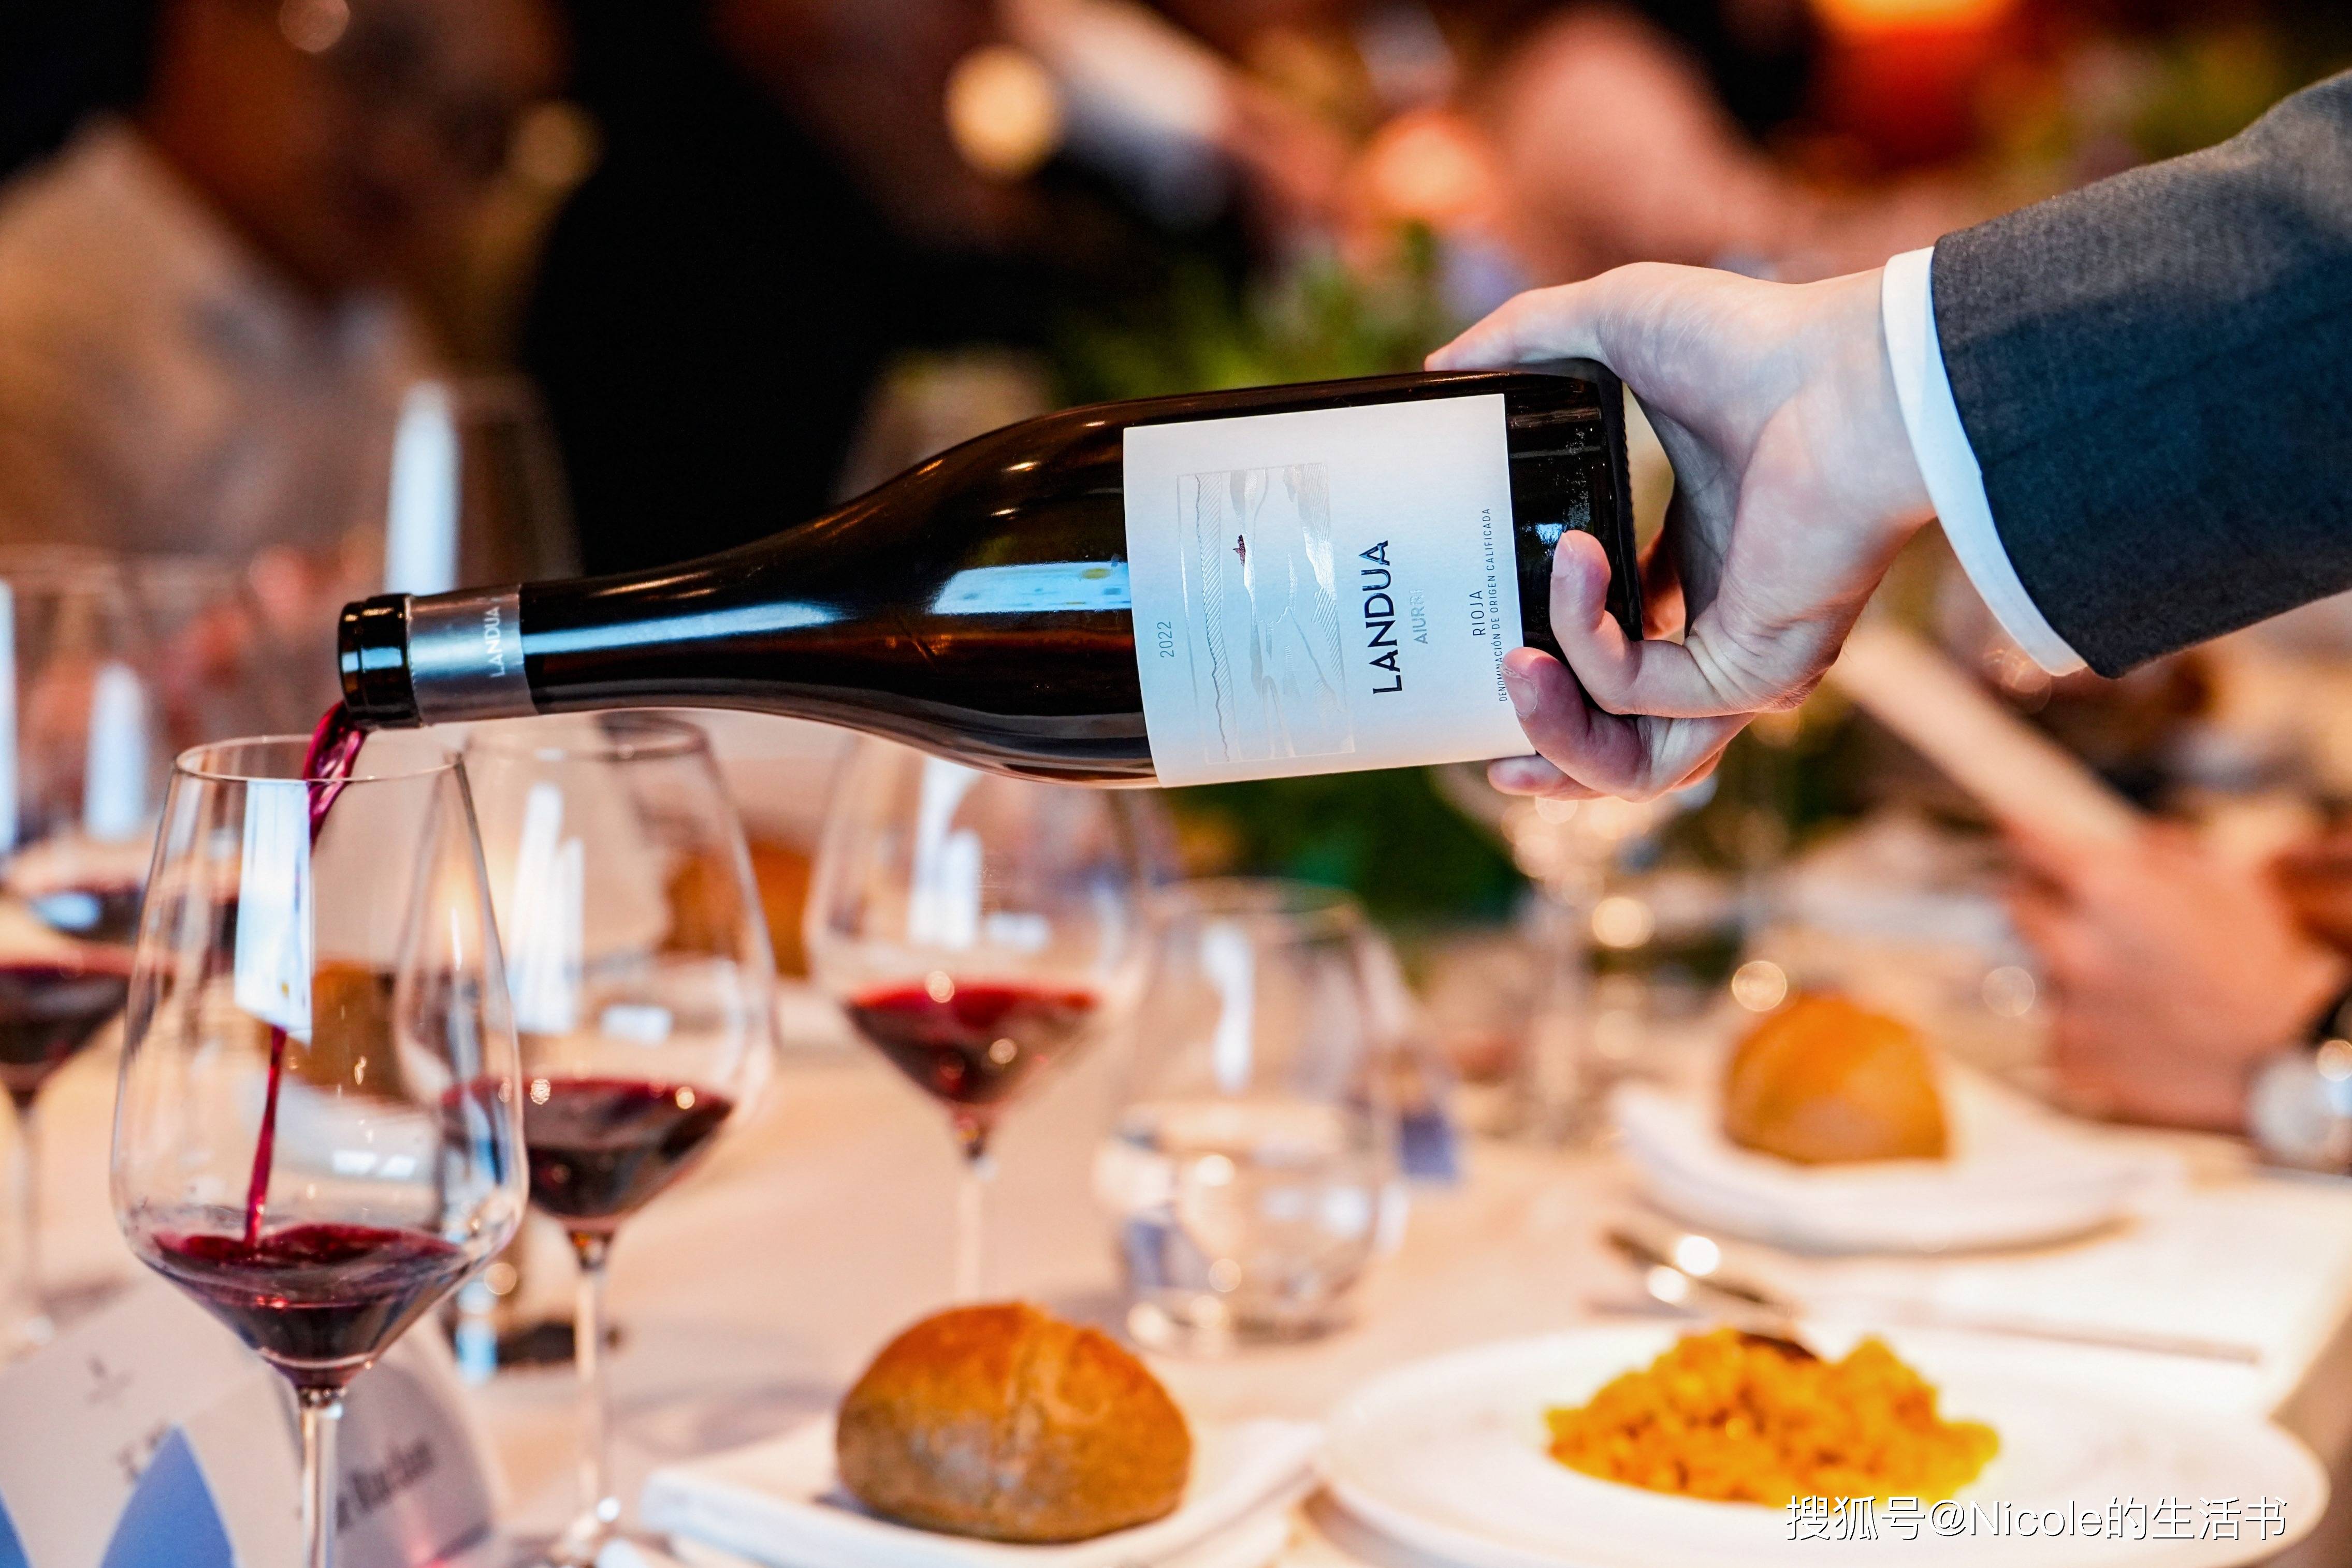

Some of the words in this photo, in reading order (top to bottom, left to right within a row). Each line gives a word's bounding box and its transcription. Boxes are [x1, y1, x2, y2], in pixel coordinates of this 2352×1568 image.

[1481, 507, 1496, 570] CALIFICADA
[1358, 539, 1402, 694] LANDUA
[1469, 589, 1486, 636] RIOJA
[1487, 575, 1499, 613] ORIGEN
[484, 606, 505, 678] LANDUA
[1156, 620, 1174, 658] 2022
[1490, 617, 1500, 629] DE
